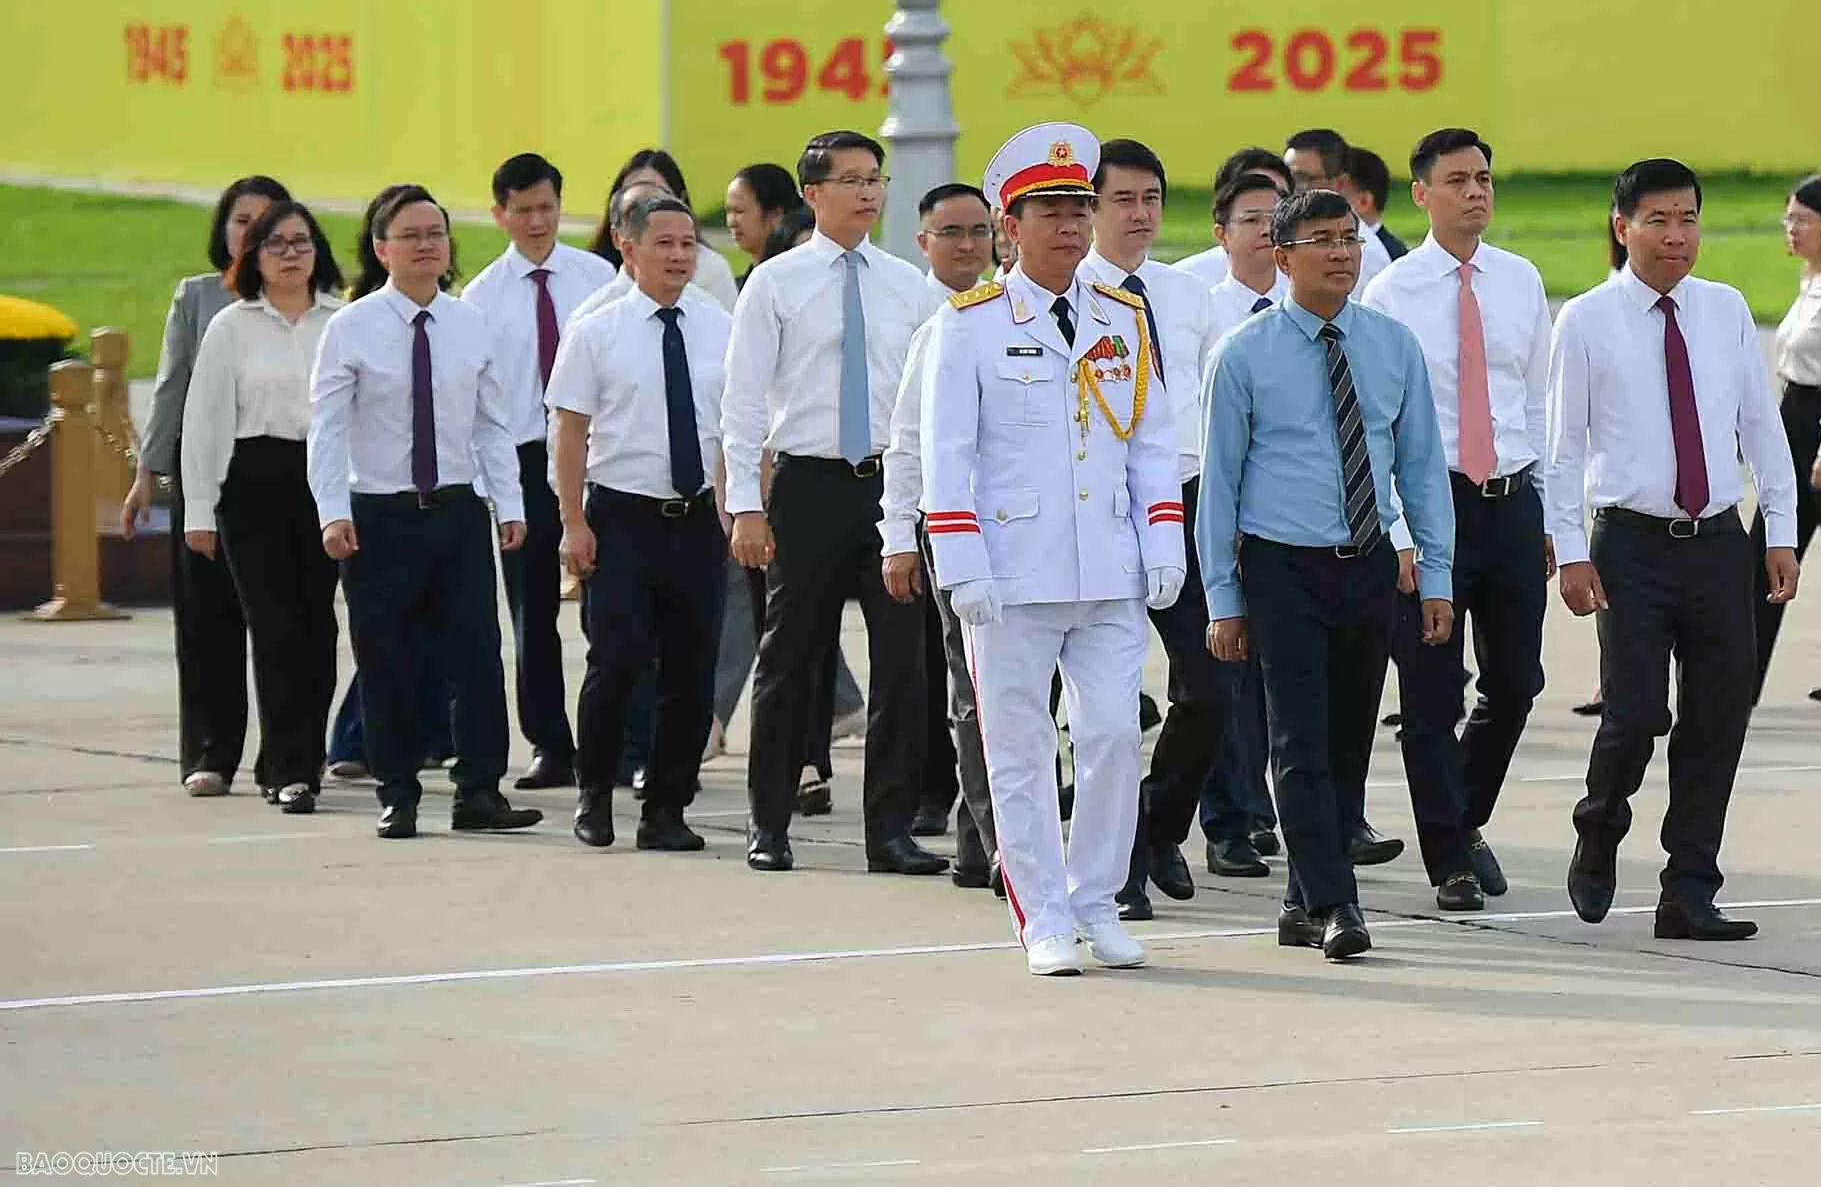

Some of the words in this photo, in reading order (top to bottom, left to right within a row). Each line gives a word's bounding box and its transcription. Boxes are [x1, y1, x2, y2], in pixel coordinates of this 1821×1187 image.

[125, 23, 190, 85] 1945
[281, 31, 355, 94] 2025
[719, 36, 897, 104] 194
[1228, 28, 1442, 94] 2025
